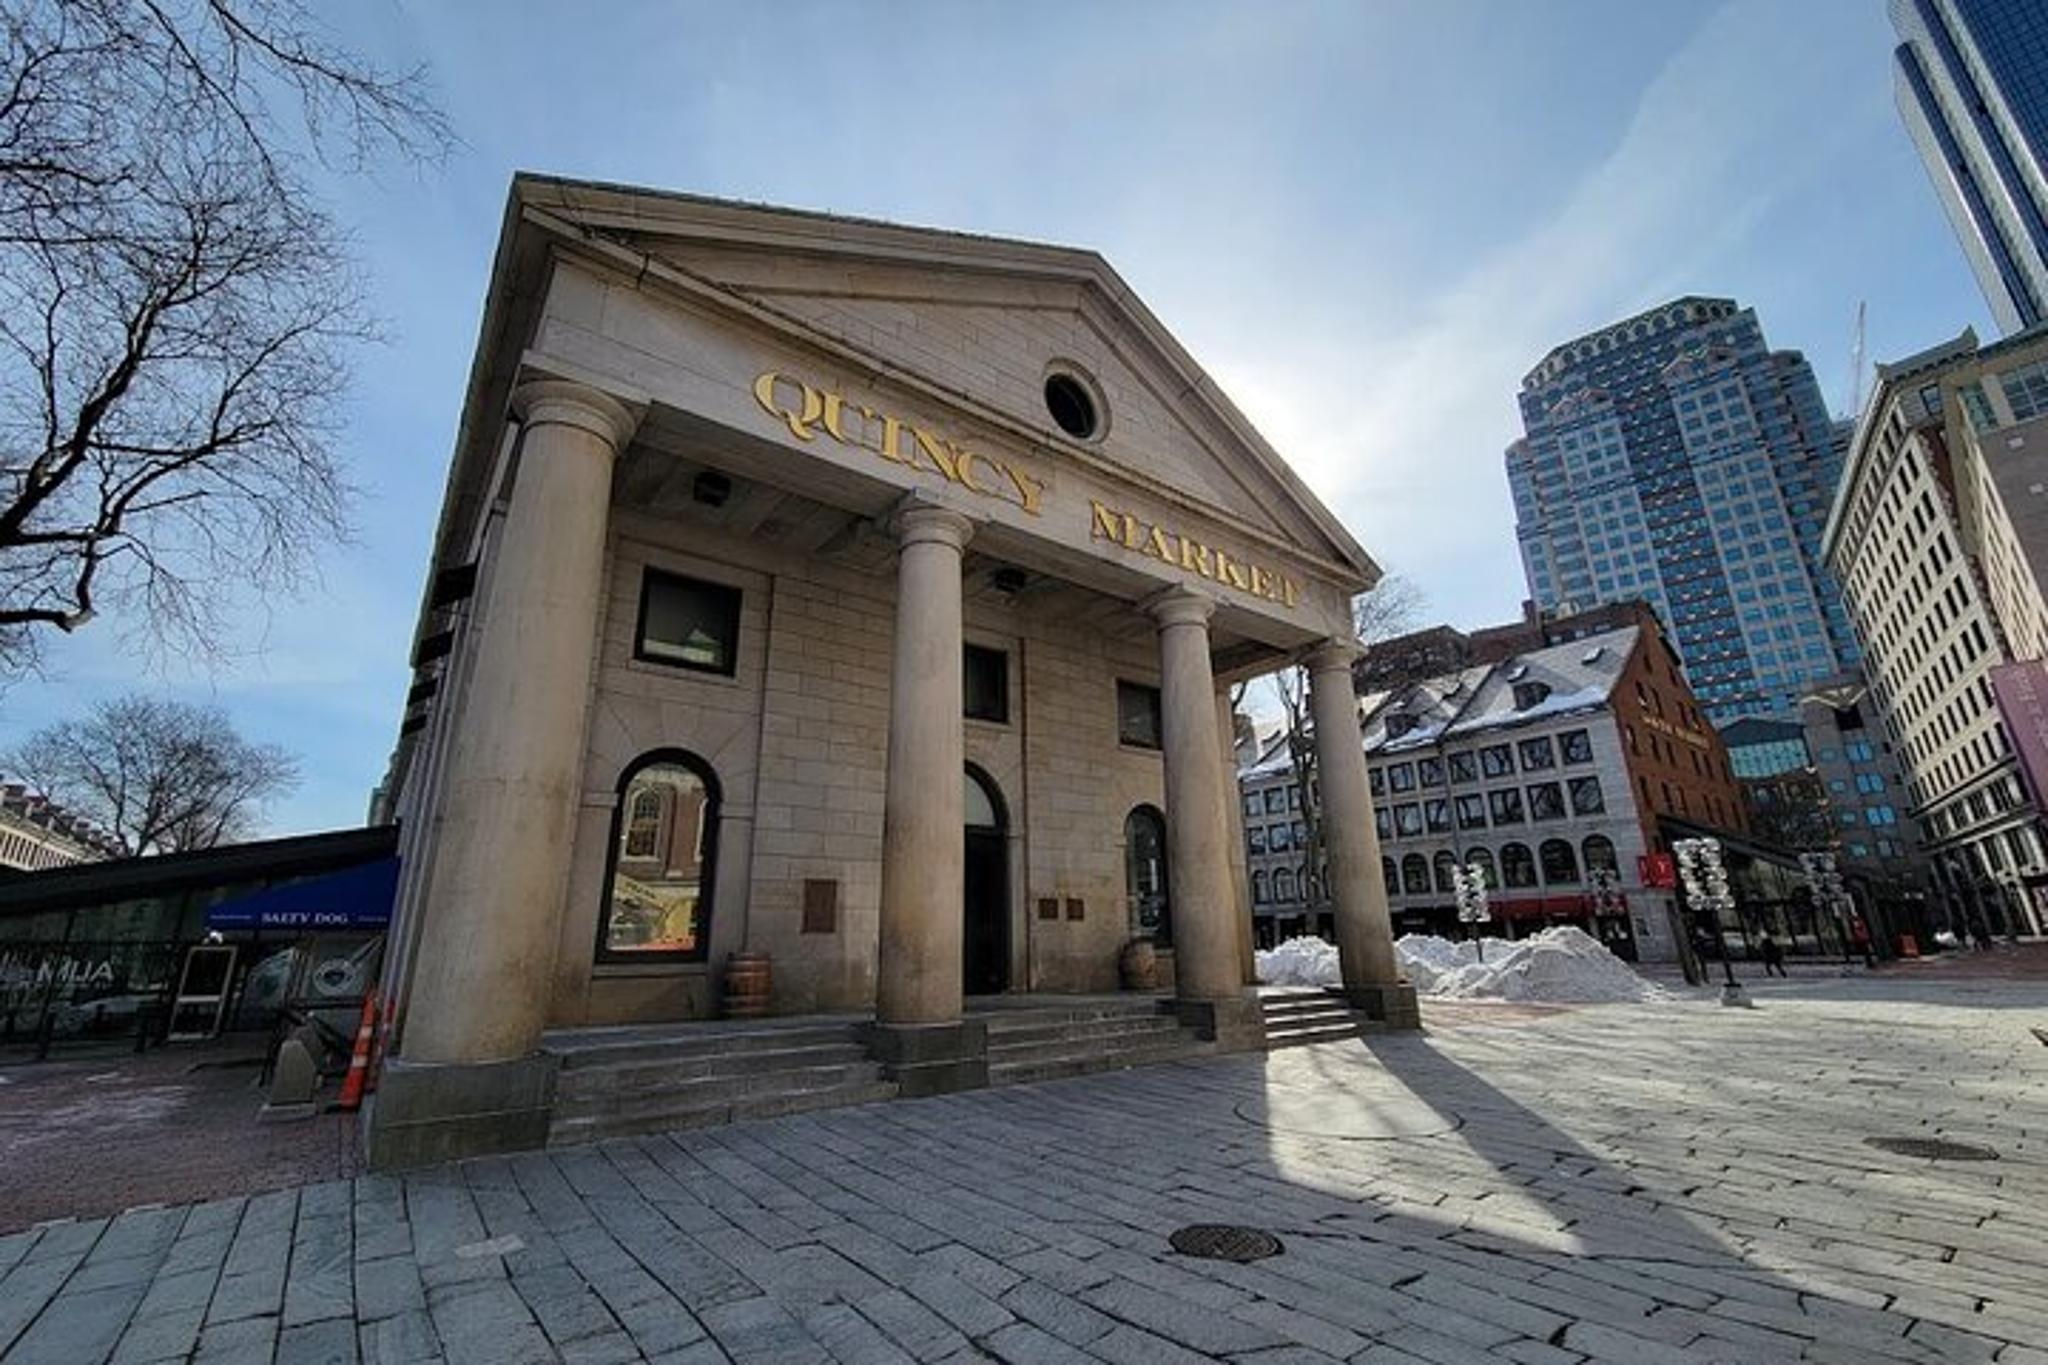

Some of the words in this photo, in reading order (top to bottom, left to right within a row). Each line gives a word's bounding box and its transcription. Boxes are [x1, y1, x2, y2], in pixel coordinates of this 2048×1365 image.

[752, 371, 1047, 516] QUINCY
[1090, 501, 1300, 608] MARKET
[261, 911, 311, 924] SALTY
[315, 911, 349, 925] DOG
